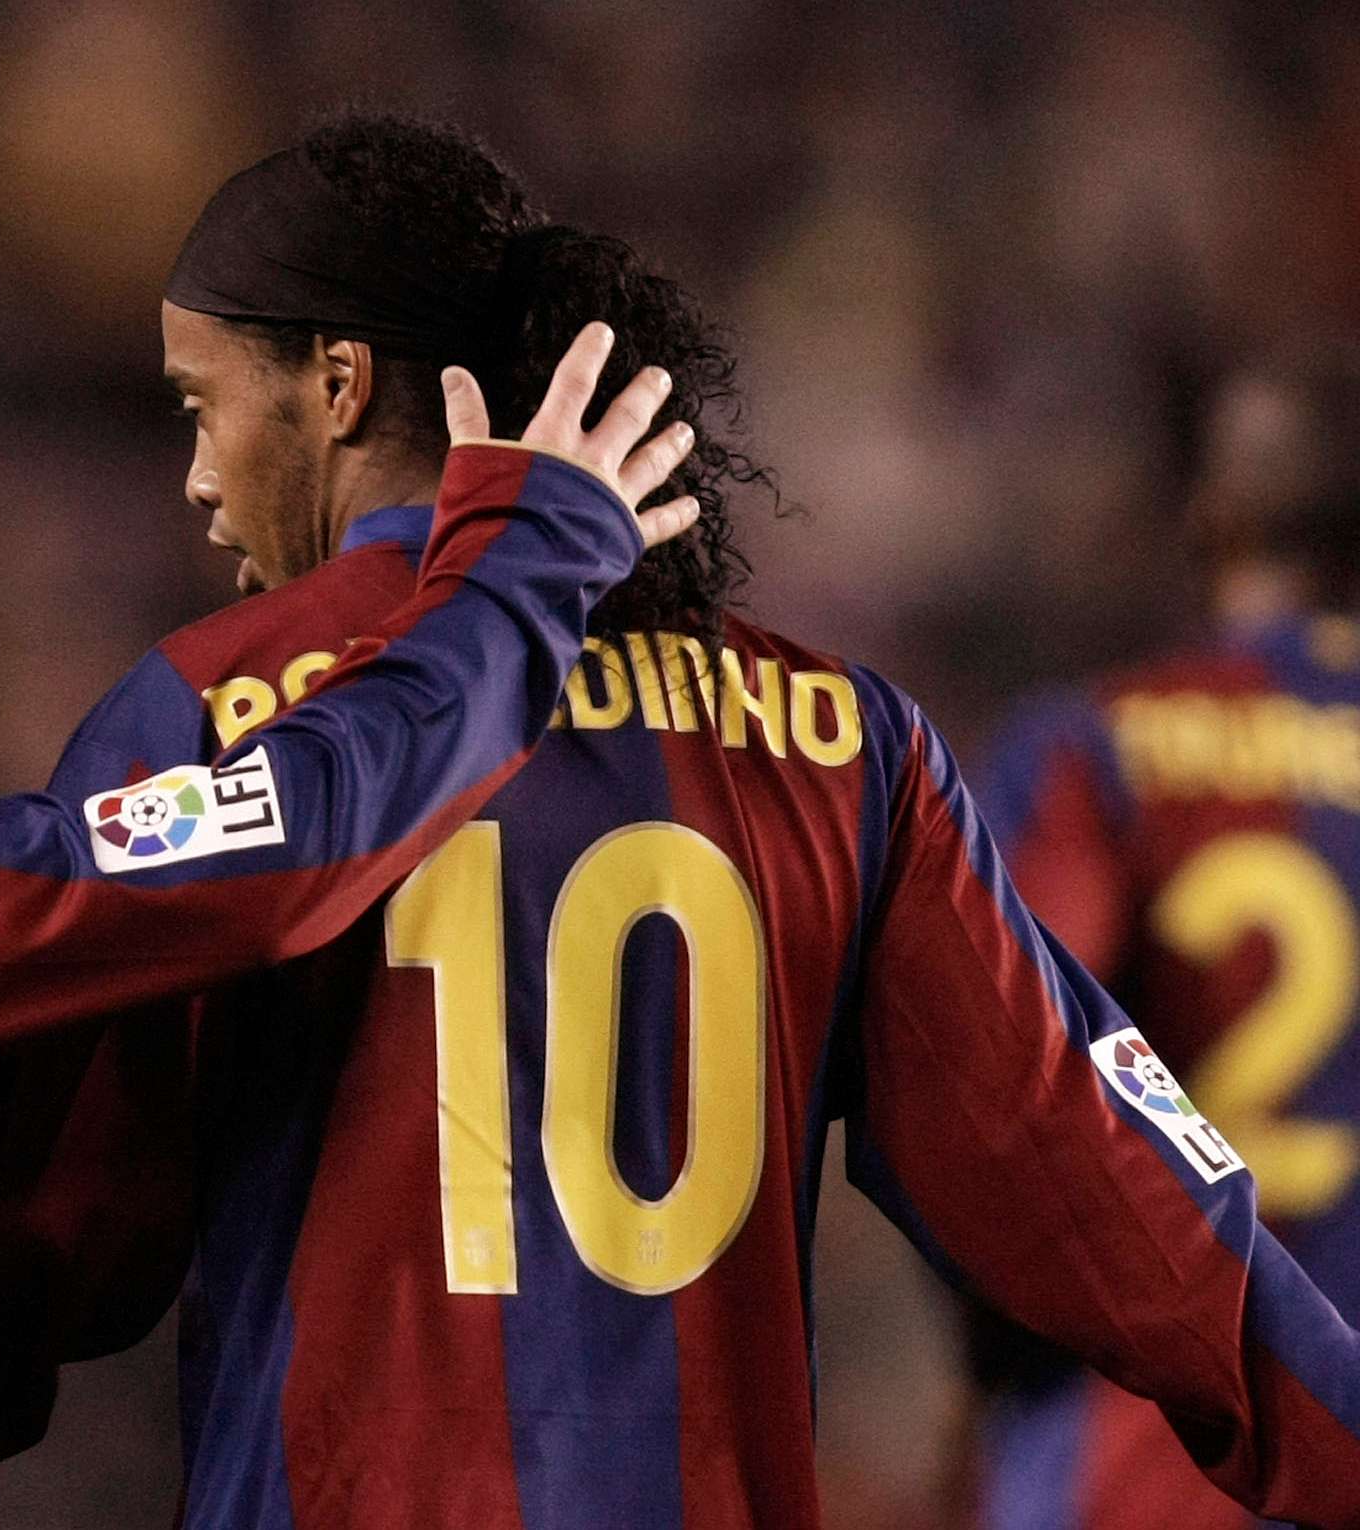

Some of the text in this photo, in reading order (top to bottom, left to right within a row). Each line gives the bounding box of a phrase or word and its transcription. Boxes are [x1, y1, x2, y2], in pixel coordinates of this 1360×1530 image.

[200, 630, 864, 768] RDINHO
[384, 820, 767, 1296] 10
[1182, 1123, 1235, 1173] LF
